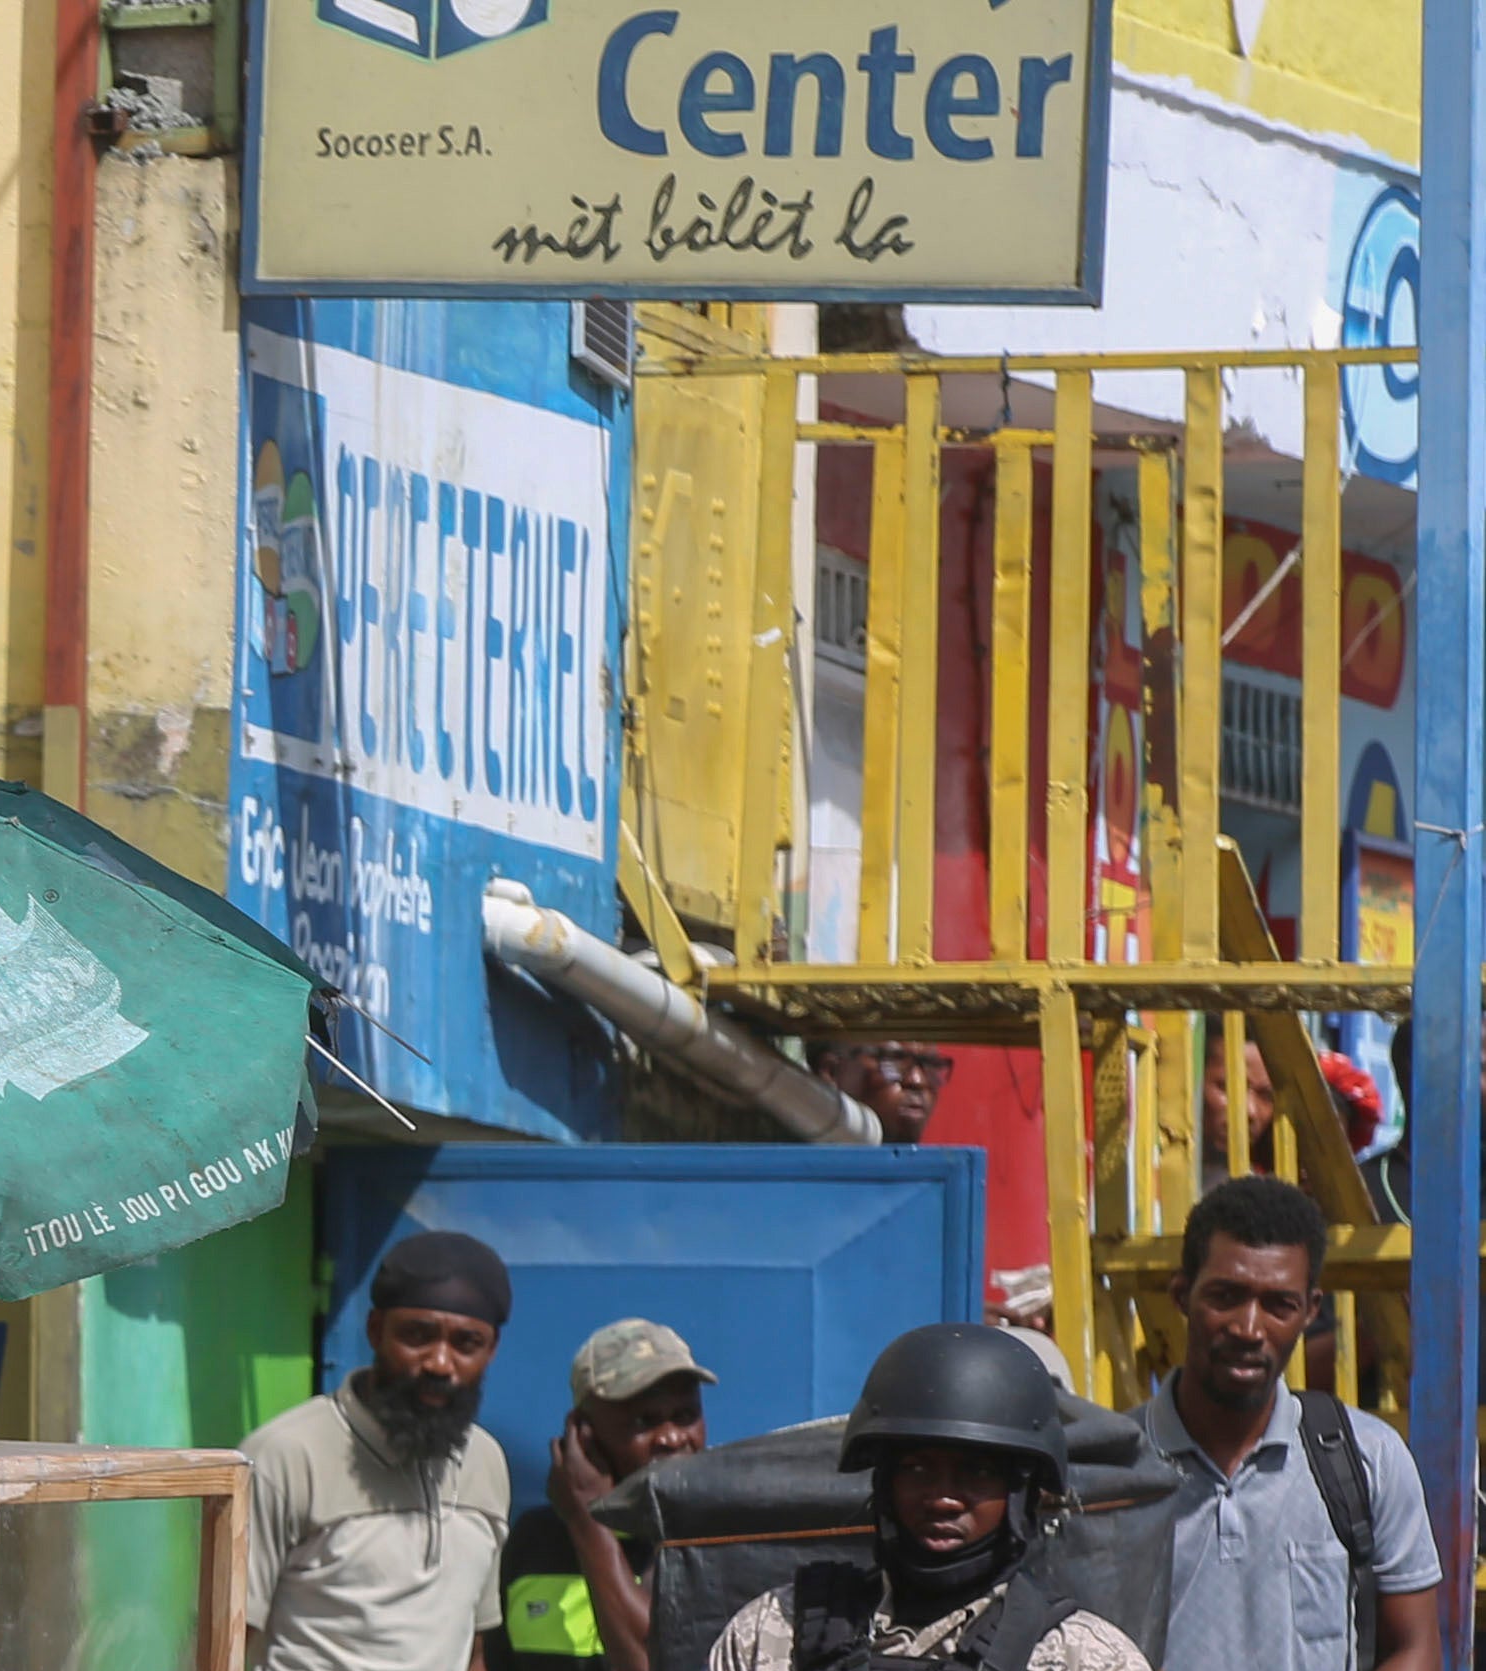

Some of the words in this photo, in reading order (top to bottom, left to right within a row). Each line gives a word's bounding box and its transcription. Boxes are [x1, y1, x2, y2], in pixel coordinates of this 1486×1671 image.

[597, 11, 1072, 162] Center
[316, 125, 431, 159] Socoser
[436, 126, 493, 158] S.A.
[492, 193, 624, 262] mèt
[836, 177, 914, 263] la
[241, 795, 284, 890] Eric
[291, 803, 343, 905] Jean
[119, 1192, 161, 1224] JOU
[159, 1180, 191, 1212] PI
[189, 1156, 243, 1199] GOU
[242, 1138, 277, 1175] AK
